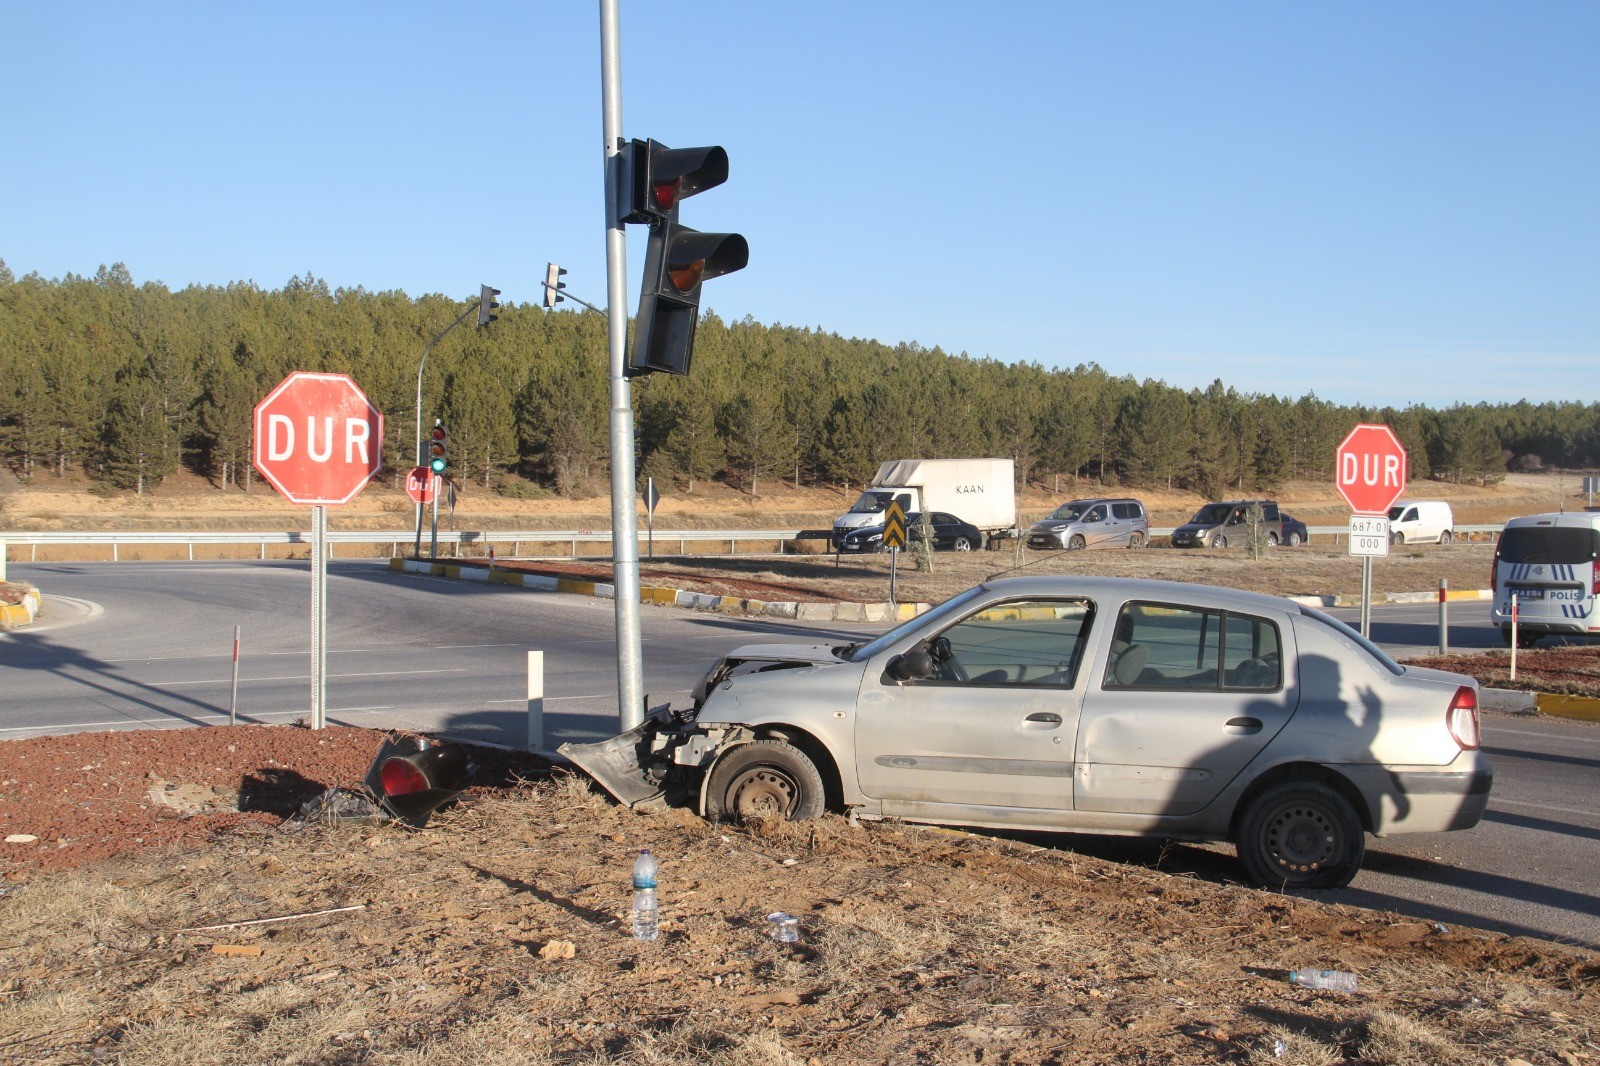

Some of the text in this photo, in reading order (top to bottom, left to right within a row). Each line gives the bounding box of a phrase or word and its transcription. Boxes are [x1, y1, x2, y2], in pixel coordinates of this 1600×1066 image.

[268, 414, 370, 464] DUR
[1342, 452, 1399, 487] DUR
[956, 485, 984, 494] KAAN
[1352, 522, 1387, 532] 687-01
[1360, 538, 1379, 549] 000
[1550, 590, 1580, 600] POLİS
